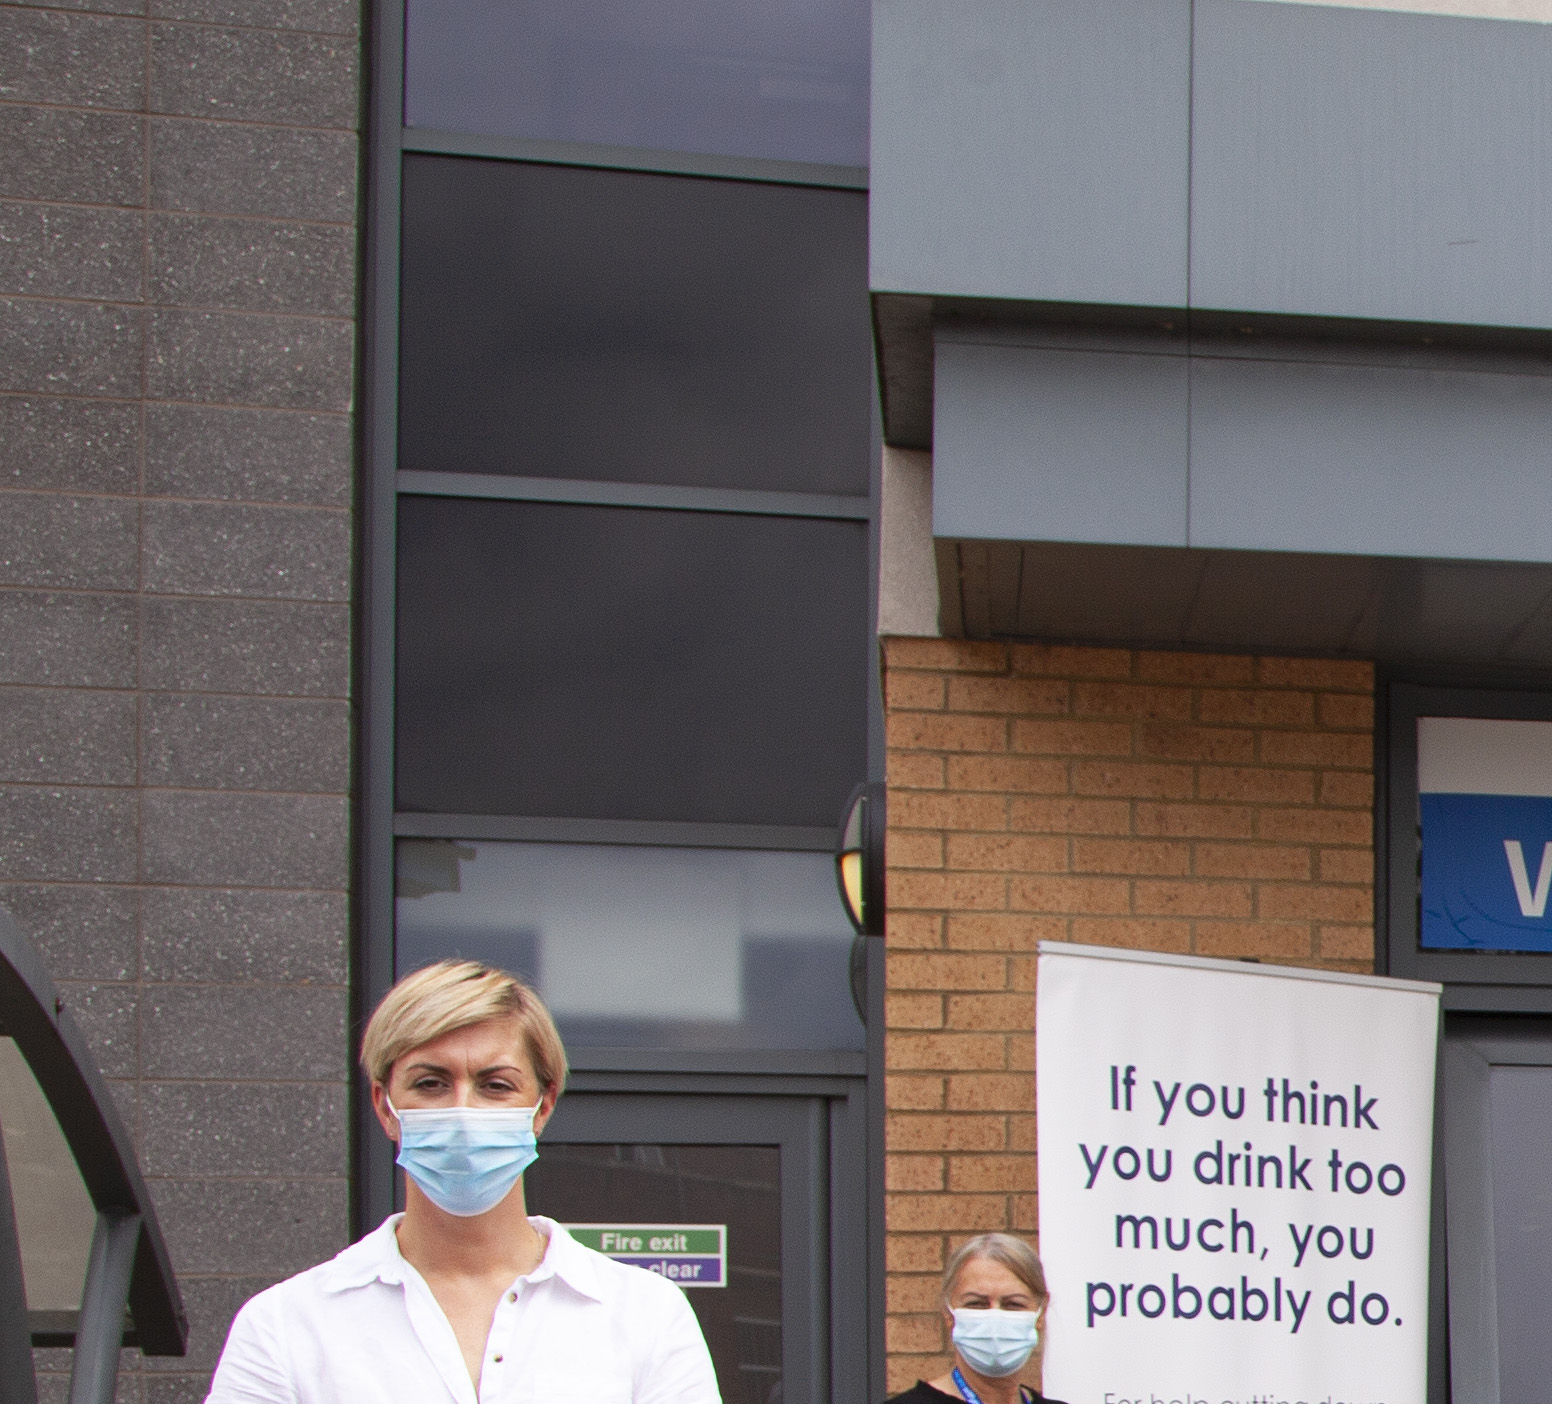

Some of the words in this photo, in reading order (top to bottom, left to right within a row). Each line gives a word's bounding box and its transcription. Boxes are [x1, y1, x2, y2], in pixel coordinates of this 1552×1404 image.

[1110, 1065, 1136, 1112] If
[1153, 1080, 1245, 1126] you
[1263, 1077, 1380, 1130] think
[1078, 1143, 1172, 1189] you
[1194, 1139, 1313, 1191] drink
[1328, 1149, 1406, 1196] too
[602, 1233, 642, 1250] Fire
[649, 1234, 687, 1251] exit
[1115, 1207, 1269, 1261] much,
[1288, 1223, 1374, 1268] you
[1086, 1272, 1312, 1334] probably
[1327, 1280, 1402, 1327] do.
